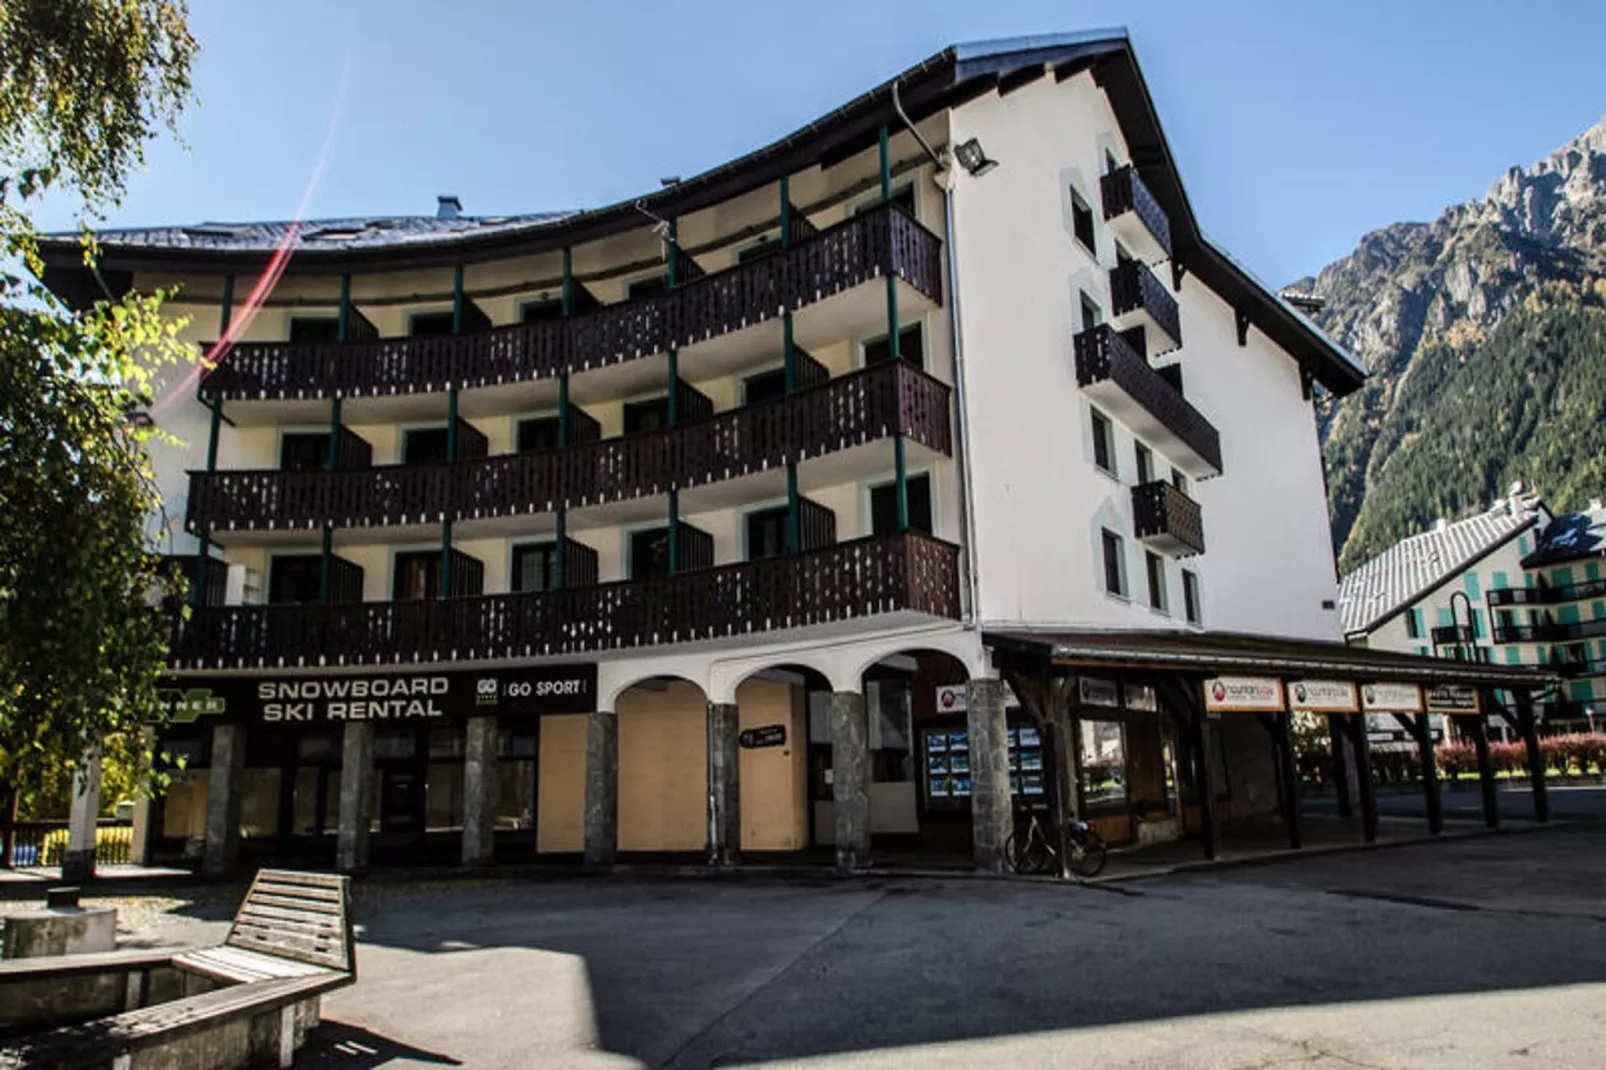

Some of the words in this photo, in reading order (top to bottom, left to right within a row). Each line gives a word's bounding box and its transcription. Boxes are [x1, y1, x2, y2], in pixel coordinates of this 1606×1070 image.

[258, 677, 449, 700] SNOWBOARD
[476, 678, 498, 694] GO
[508, 682, 532, 697] GO
[535, 679, 581, 697] SPORT
[263, 703, 314, 722] SKI
[326, 699, 443, 720] RENTAL
